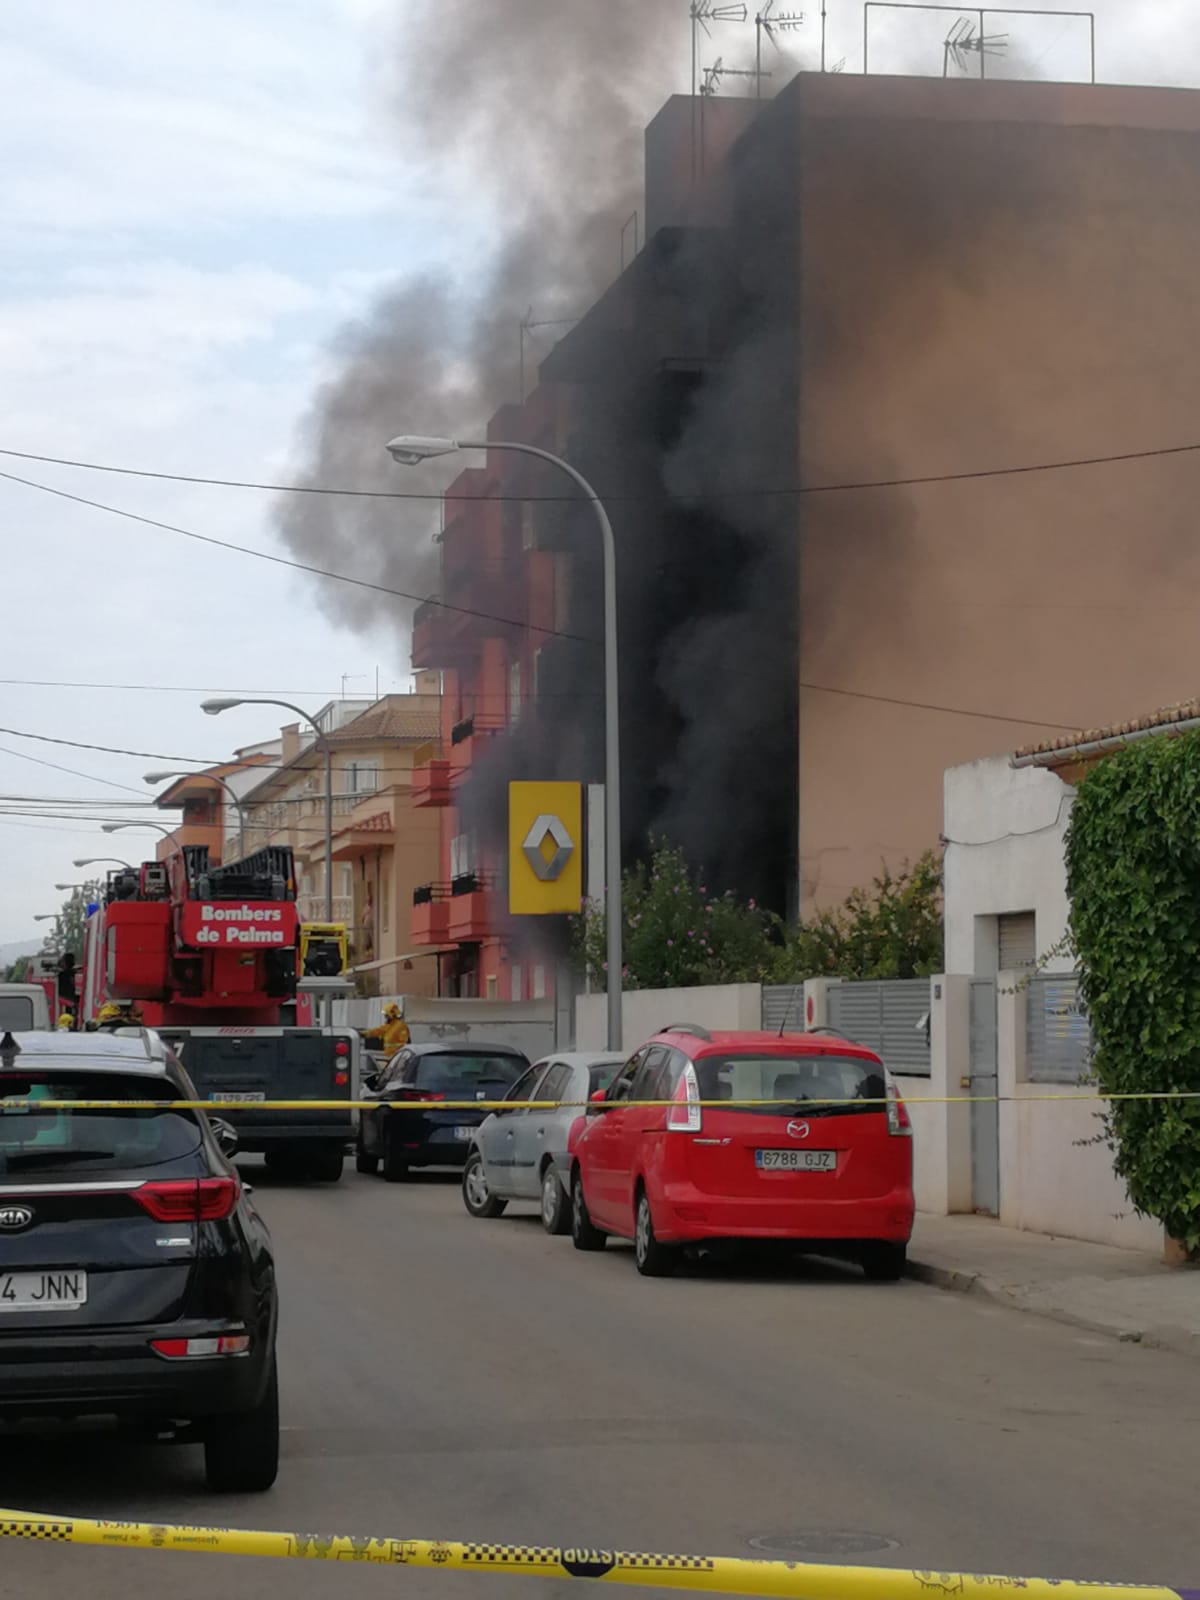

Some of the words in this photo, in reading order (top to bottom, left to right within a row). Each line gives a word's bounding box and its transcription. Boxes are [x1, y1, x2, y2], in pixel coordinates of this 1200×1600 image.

[201, 904, 281, 921] Bombers
[196, 926, 219, 942] de
[226, 925, 284, 942] Palma
[763, 1152, 798, 1166] 6788
[805, 1153, 831, 1167] GJZ
[0, 1212, 25, 1224] KIA
[32, 1274, 79, 1300] JNN
[563, 1548, 613, 1564] STOP
